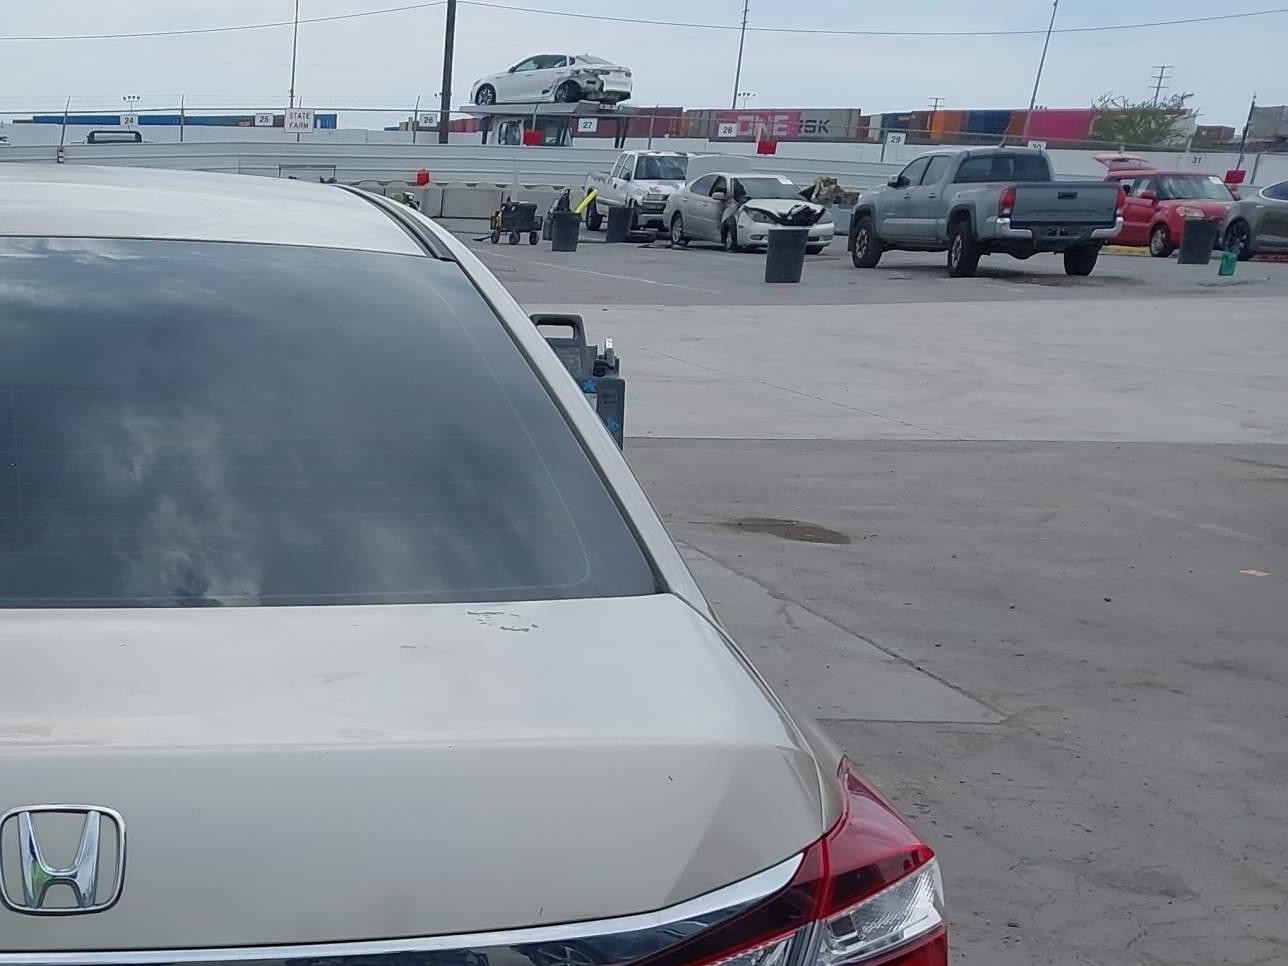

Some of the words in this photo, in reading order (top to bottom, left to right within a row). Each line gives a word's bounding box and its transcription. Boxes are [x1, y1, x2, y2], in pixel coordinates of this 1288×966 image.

[259, 115, 269, 123] 25
[289, 111, 311, 120] STATE
[124, 116, 134, 125] 24
[423, 116, 434, 124] 26
[289, 121, 309, 130] FARM
[582, 121, 593, 129] 27
[890, 135, 901, 143] 29
